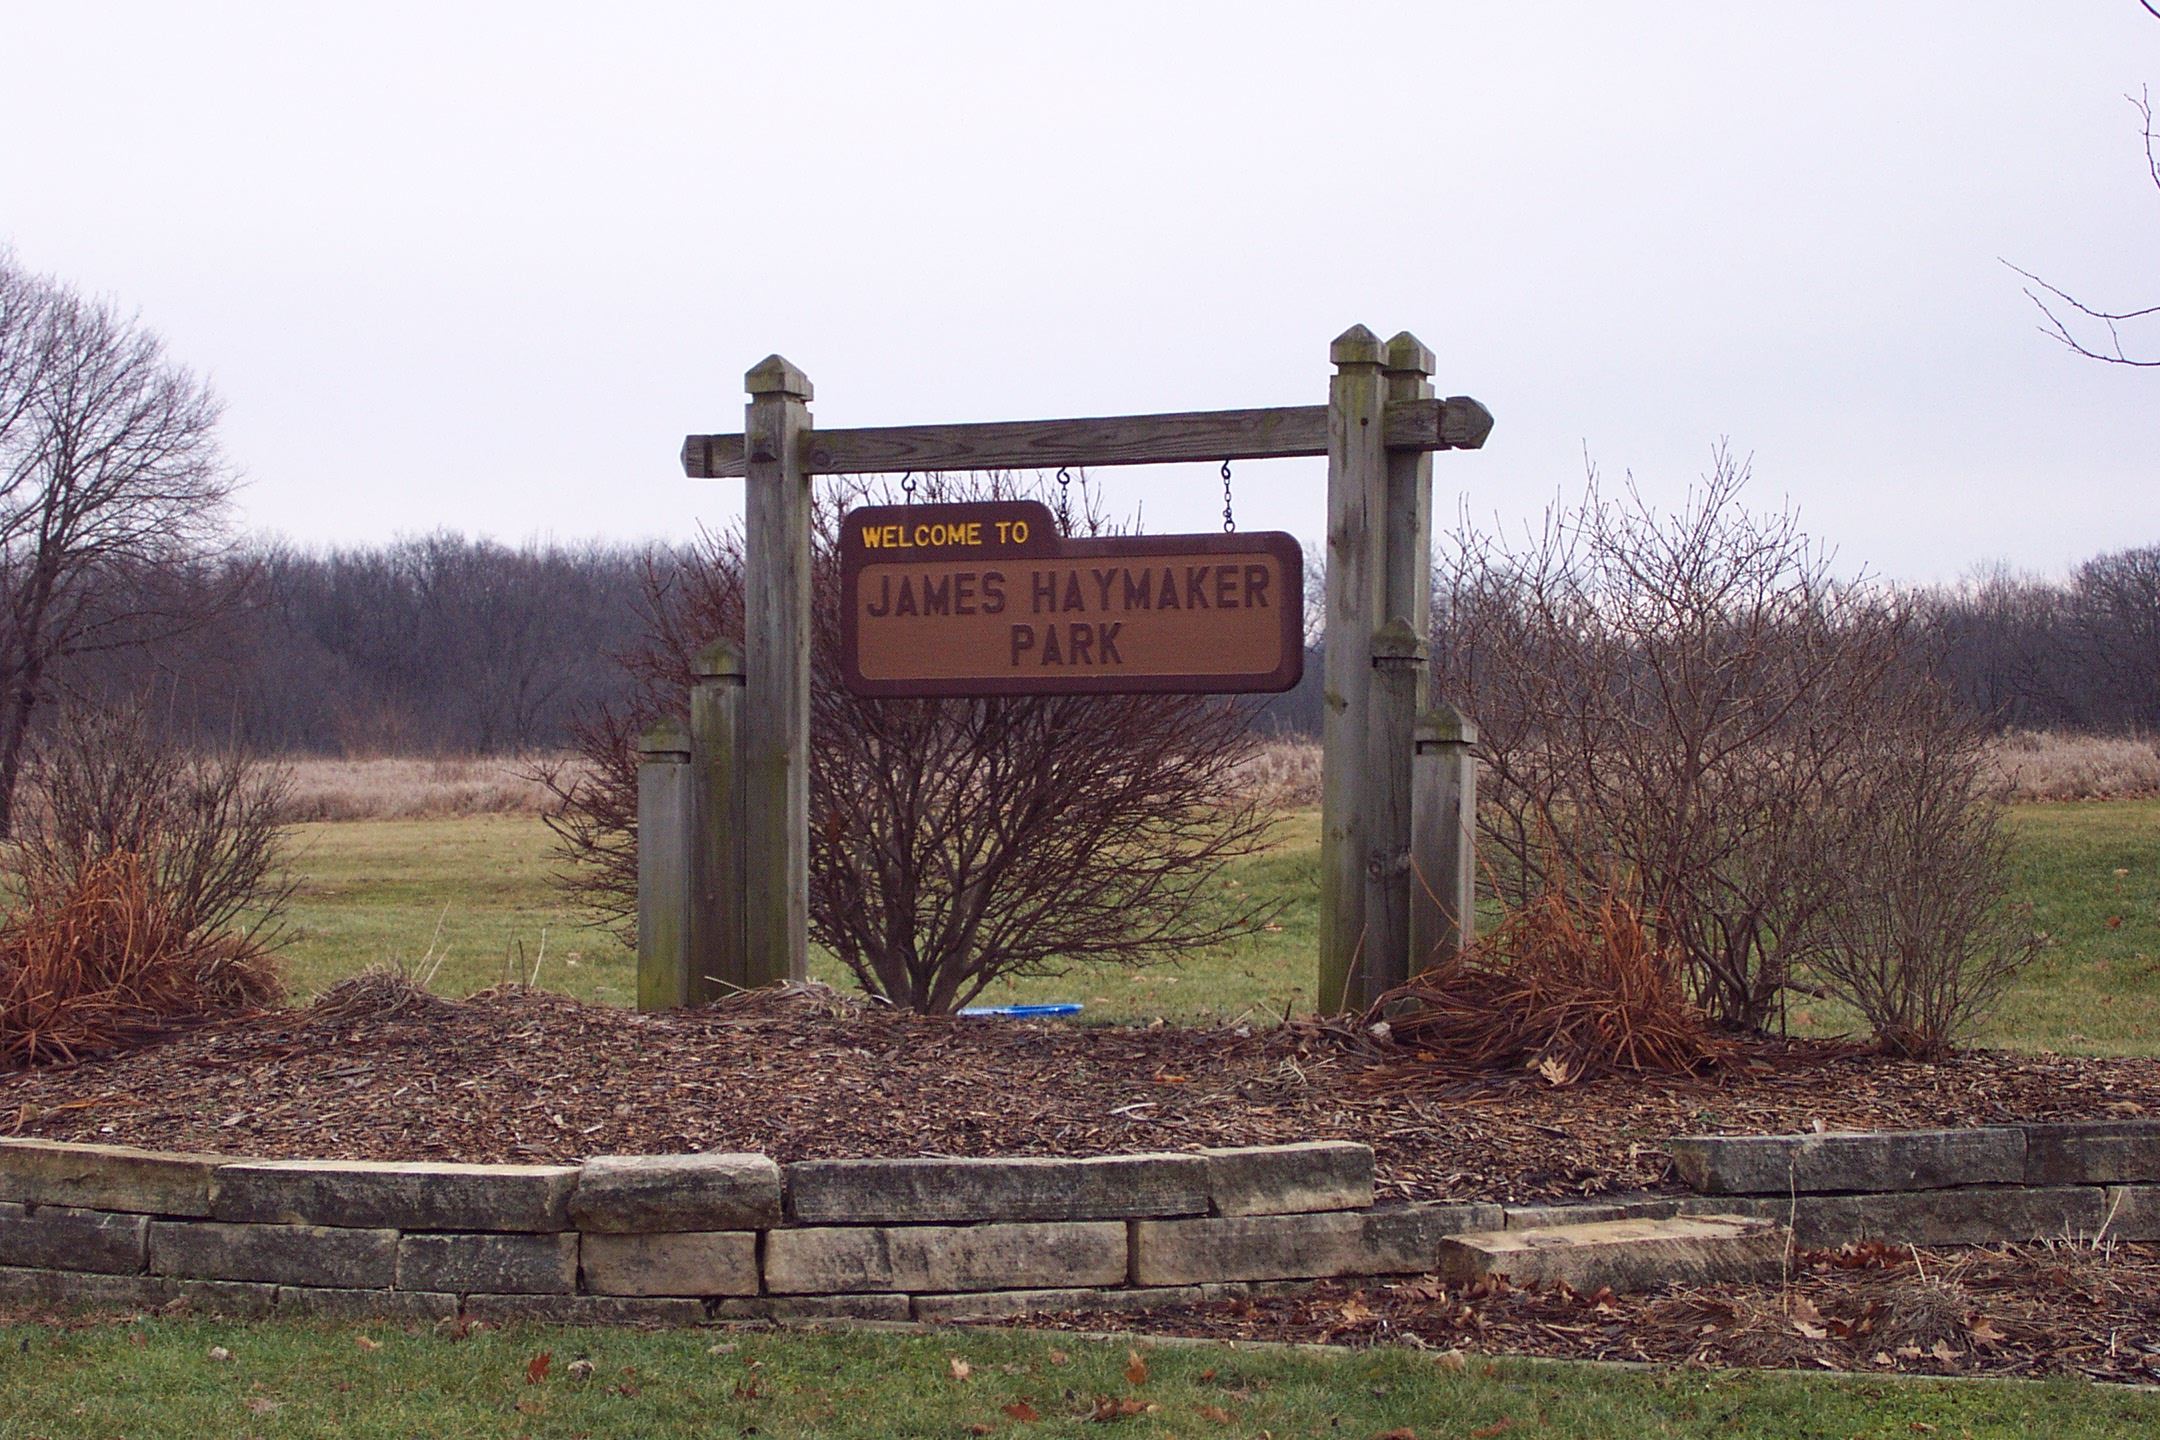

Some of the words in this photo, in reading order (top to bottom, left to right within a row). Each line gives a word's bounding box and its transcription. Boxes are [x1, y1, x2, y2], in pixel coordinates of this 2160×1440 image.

[861, 522, 982, 549] WELCOME
[995, 521, 1029, 544] TO
[867, 571, 1006, 616] JAMES
[1032, 564, 1270, 613] HAYMAKER
[1010, 621, 1124, 667] PARK
